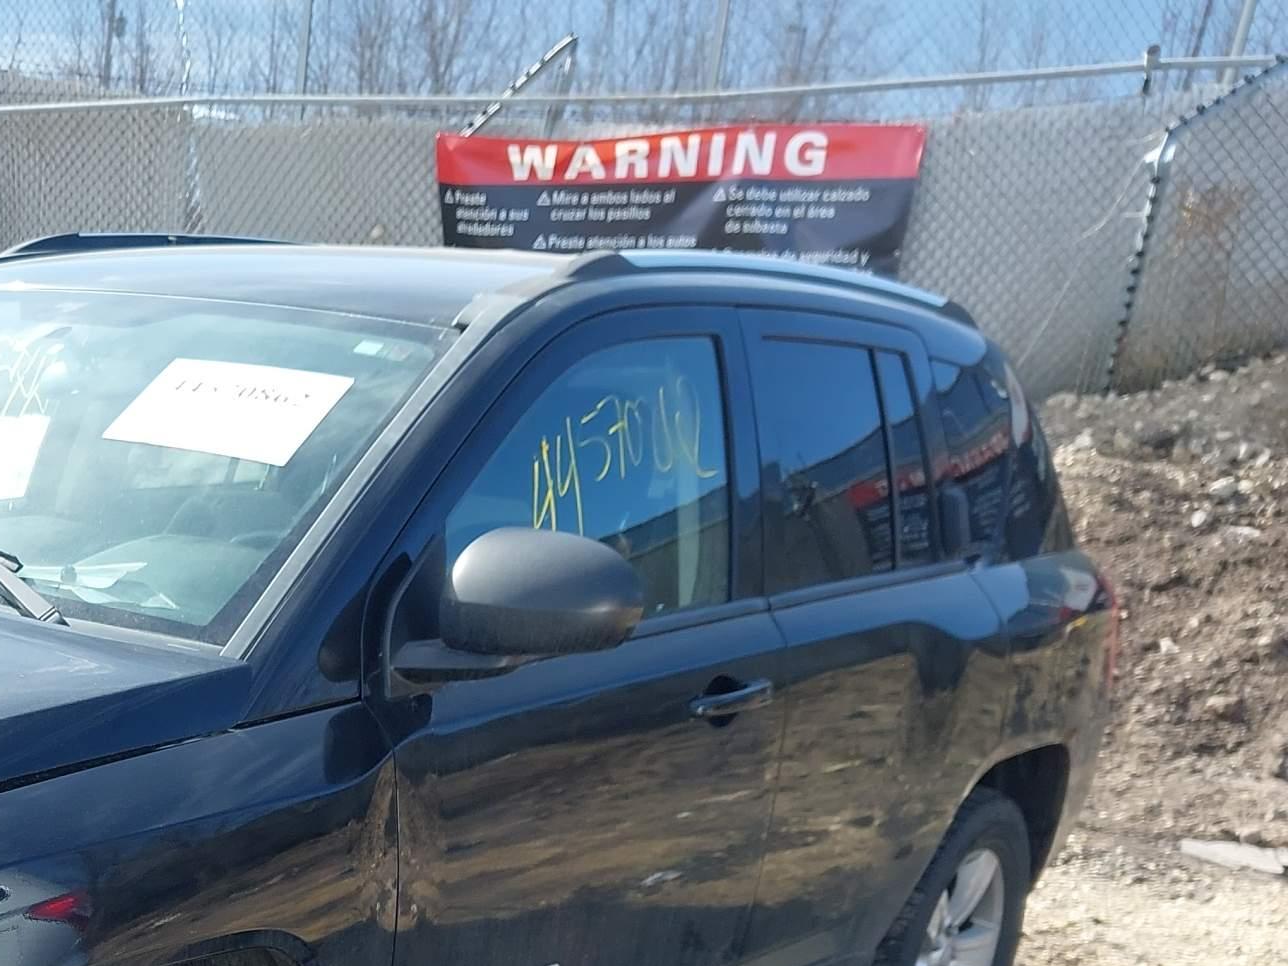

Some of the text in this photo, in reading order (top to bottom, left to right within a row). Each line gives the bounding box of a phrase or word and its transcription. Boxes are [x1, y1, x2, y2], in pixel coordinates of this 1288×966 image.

[507, 130, 829, 182] WARNING
[552, 189, 579, 205] Mire
[581, 191, 589, 205] a
[590, 190, 628, 205] ambos
[630, 188, 662, 204] lados
[746, 186, 777, 201] debe
[822, 186, 870, 202] calzado
[587, 206, 606, 221] los
[607, 205, 652, 223] pasillos
[774, 205, 792, 217] en
[793, 204, 806, 218] el
[725, 219, 741, 234] de
[547, 233, 585, 249] Preste
